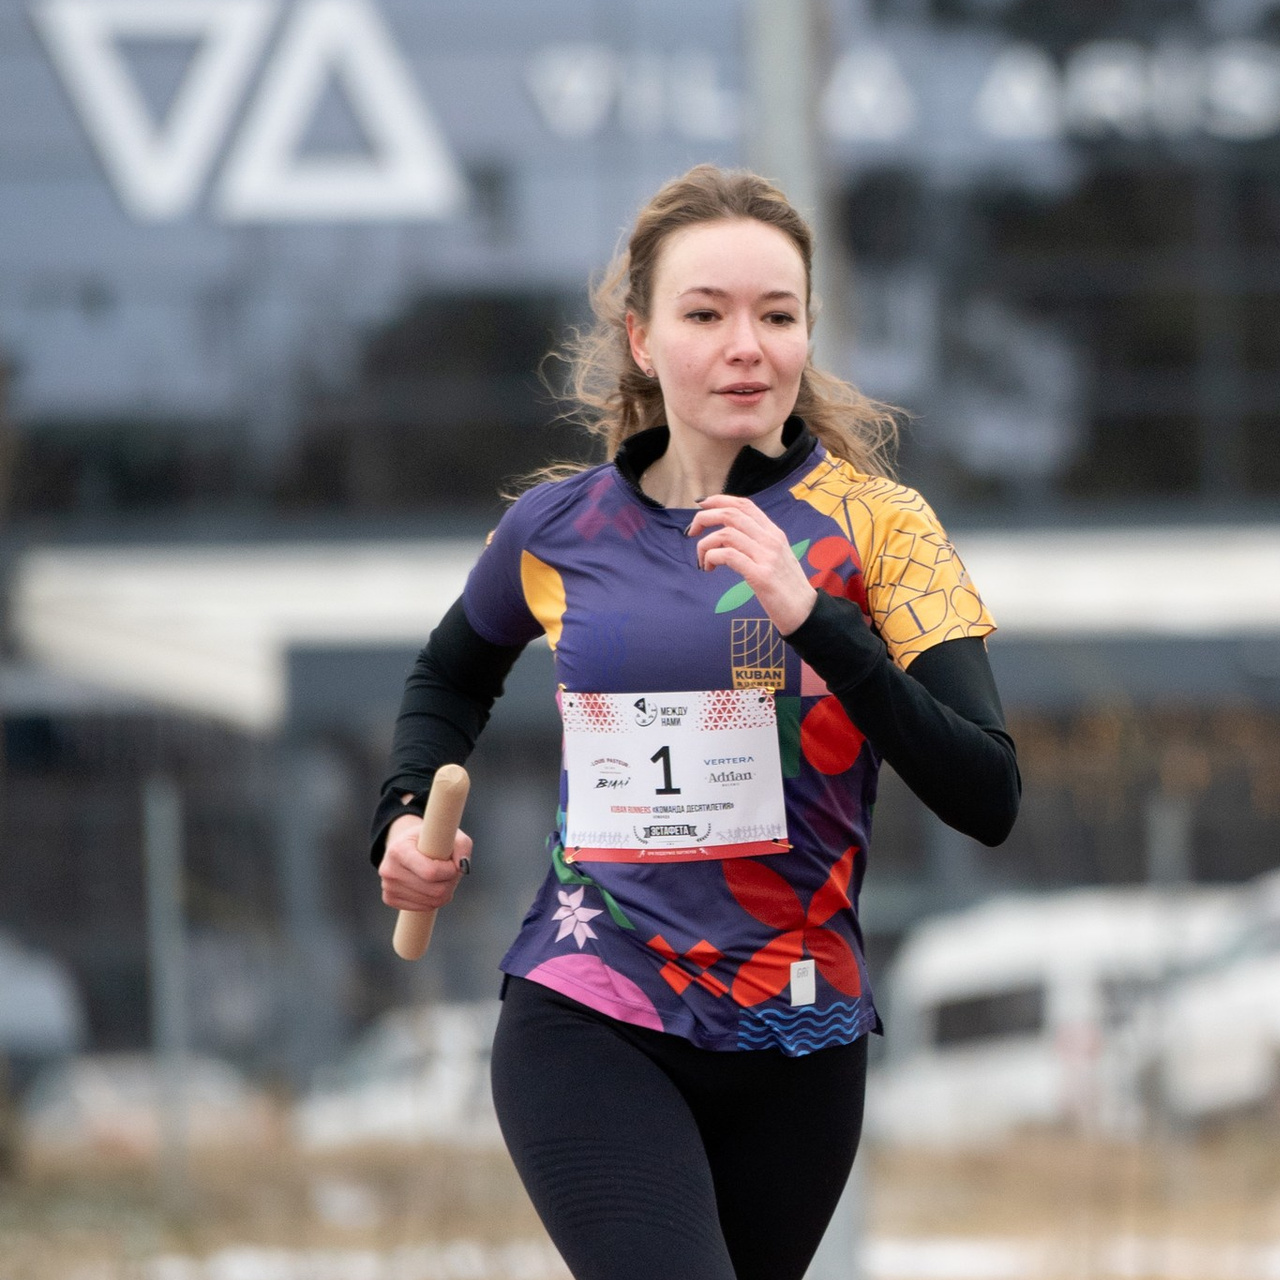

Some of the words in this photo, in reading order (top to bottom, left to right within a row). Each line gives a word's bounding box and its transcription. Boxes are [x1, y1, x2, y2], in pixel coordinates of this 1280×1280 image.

[528, 43, 912, 140] VILA
[735, 670, 782, 680] KUBAN
[660, 706, 688, 715] МЕЖДУ
[661, 718, 682, 726] НАМИ
[703, 756, 755, 766] VERTERA
[650, 745, 681, 795] 1
[708, 771, 753, 783] Adrian
[650, 825, 689, 836] ЭСТАФЕТА
